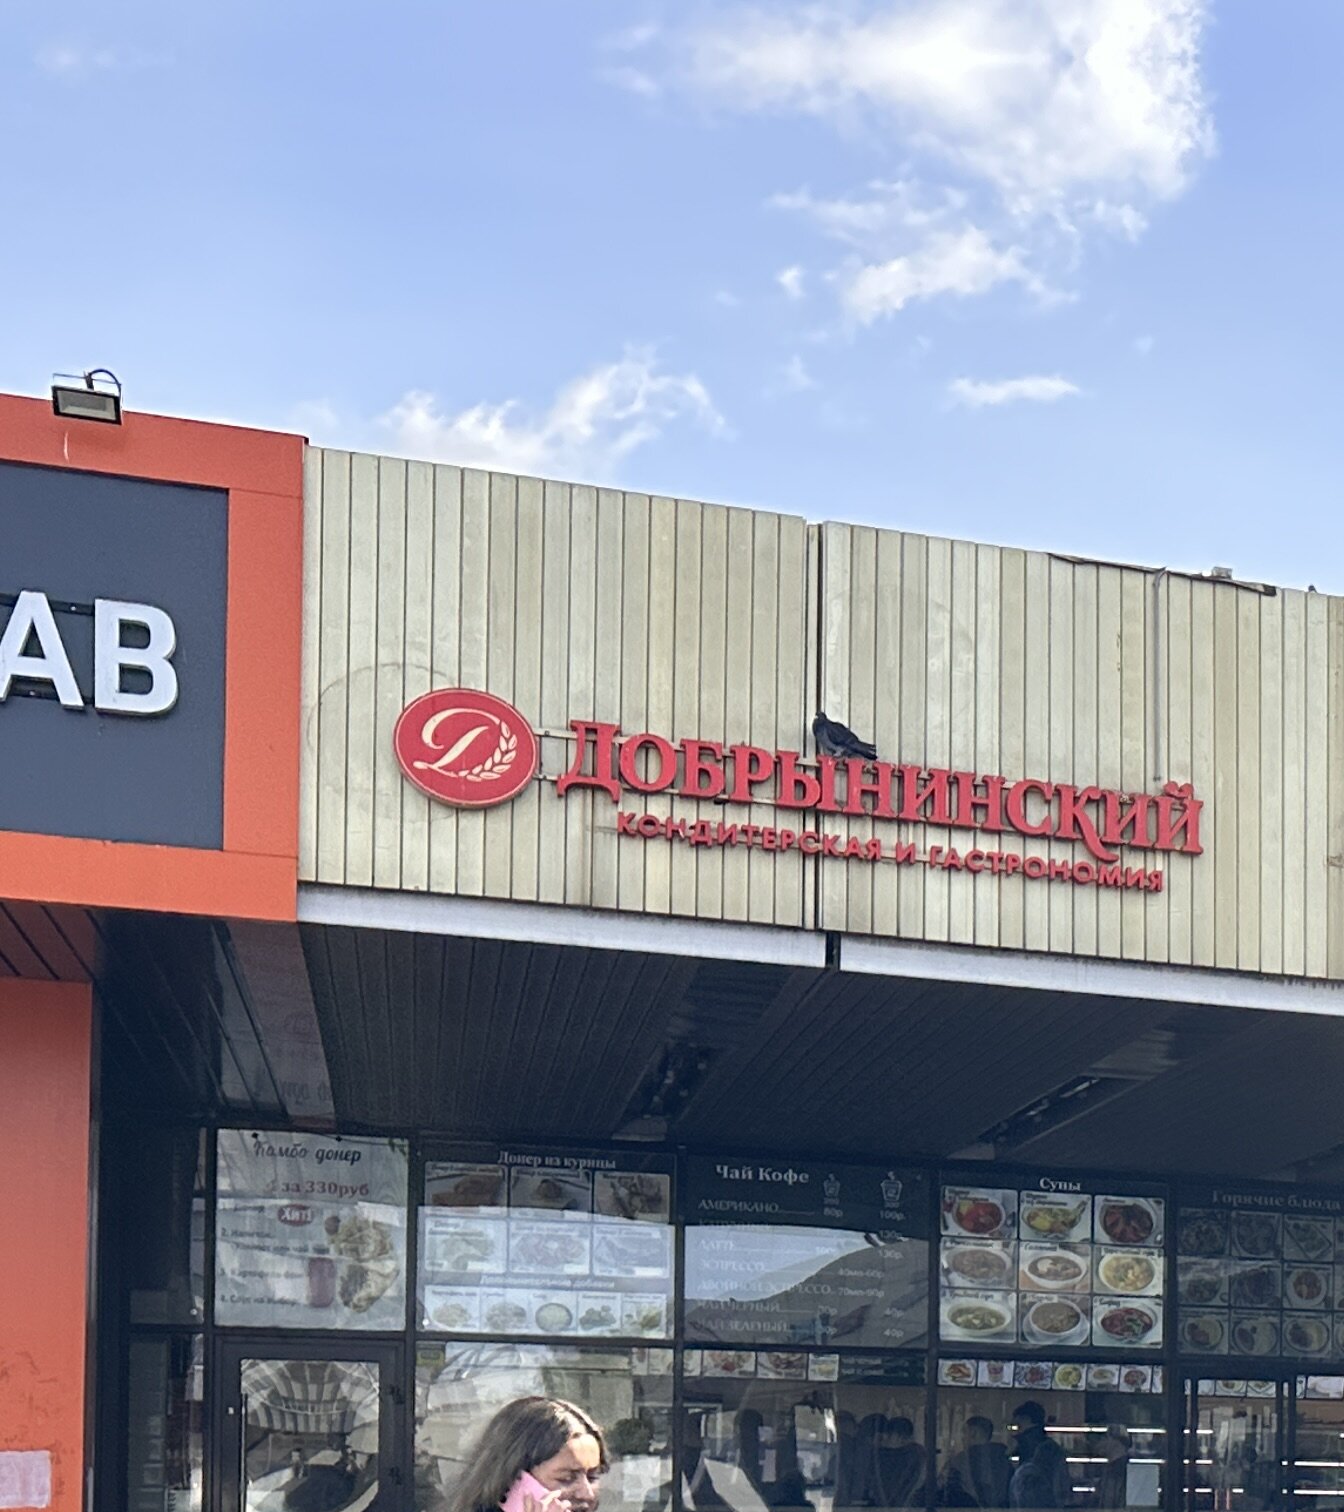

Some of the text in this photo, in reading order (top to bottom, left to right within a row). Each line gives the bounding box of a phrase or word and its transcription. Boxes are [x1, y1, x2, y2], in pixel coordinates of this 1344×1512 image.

[556, 719, 1203, 862] ДОБРЫНИНСКИЙ
[616, 810, 1165, 892] КОНДИТЕРСКАЯ И ГАСТРОНОМИЯ
[715, 1163, 810, 1186] Чай Кофе
[1039, 1177, 1081, 1192] Супы
[1212, 1190, 1341, 1211] Горячие блюда
